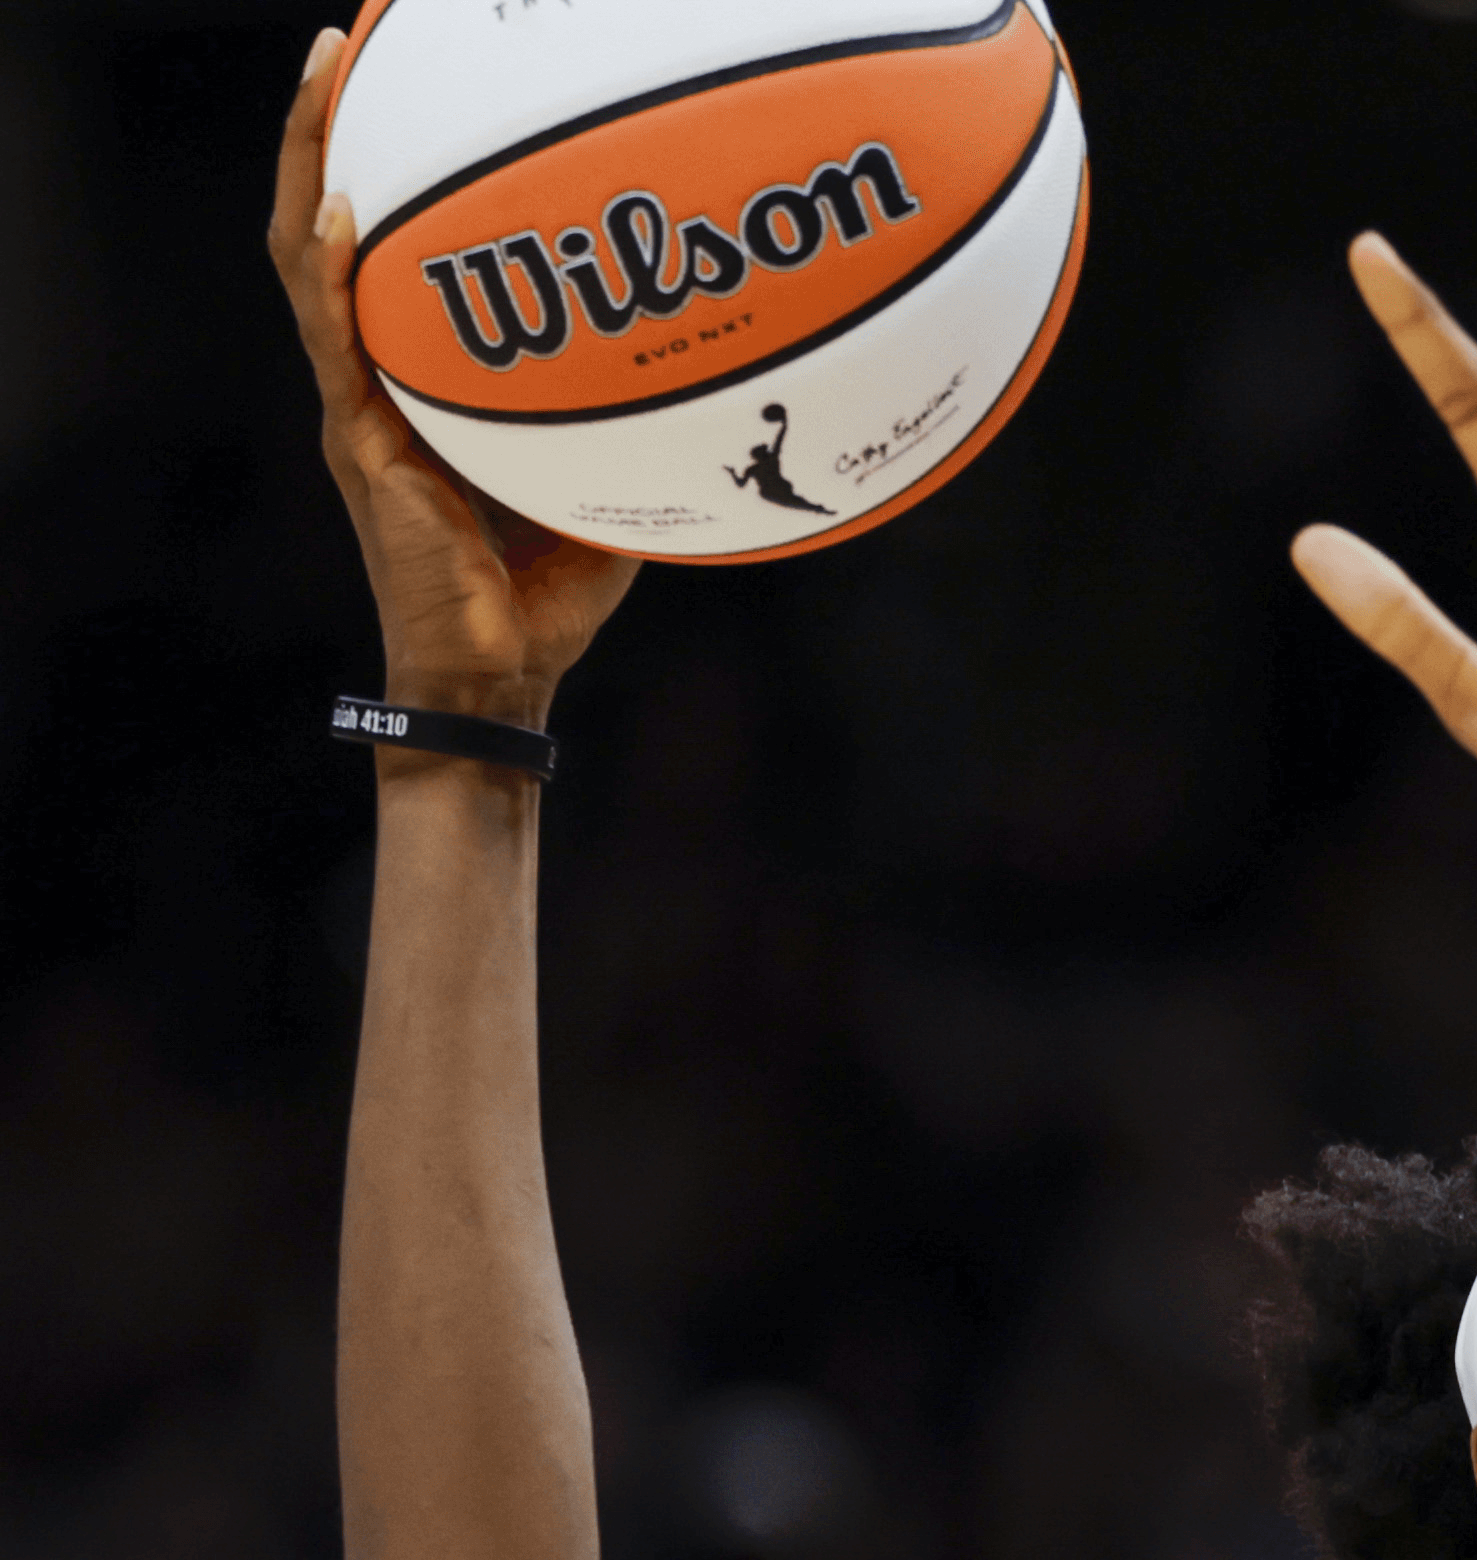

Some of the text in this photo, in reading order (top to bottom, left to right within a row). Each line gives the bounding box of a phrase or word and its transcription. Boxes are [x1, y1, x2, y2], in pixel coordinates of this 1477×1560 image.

[420, 141, 922, 373] Wilson
[632, 338, 690, 366] EVO
[360, 708, 409, 737] 41:10
